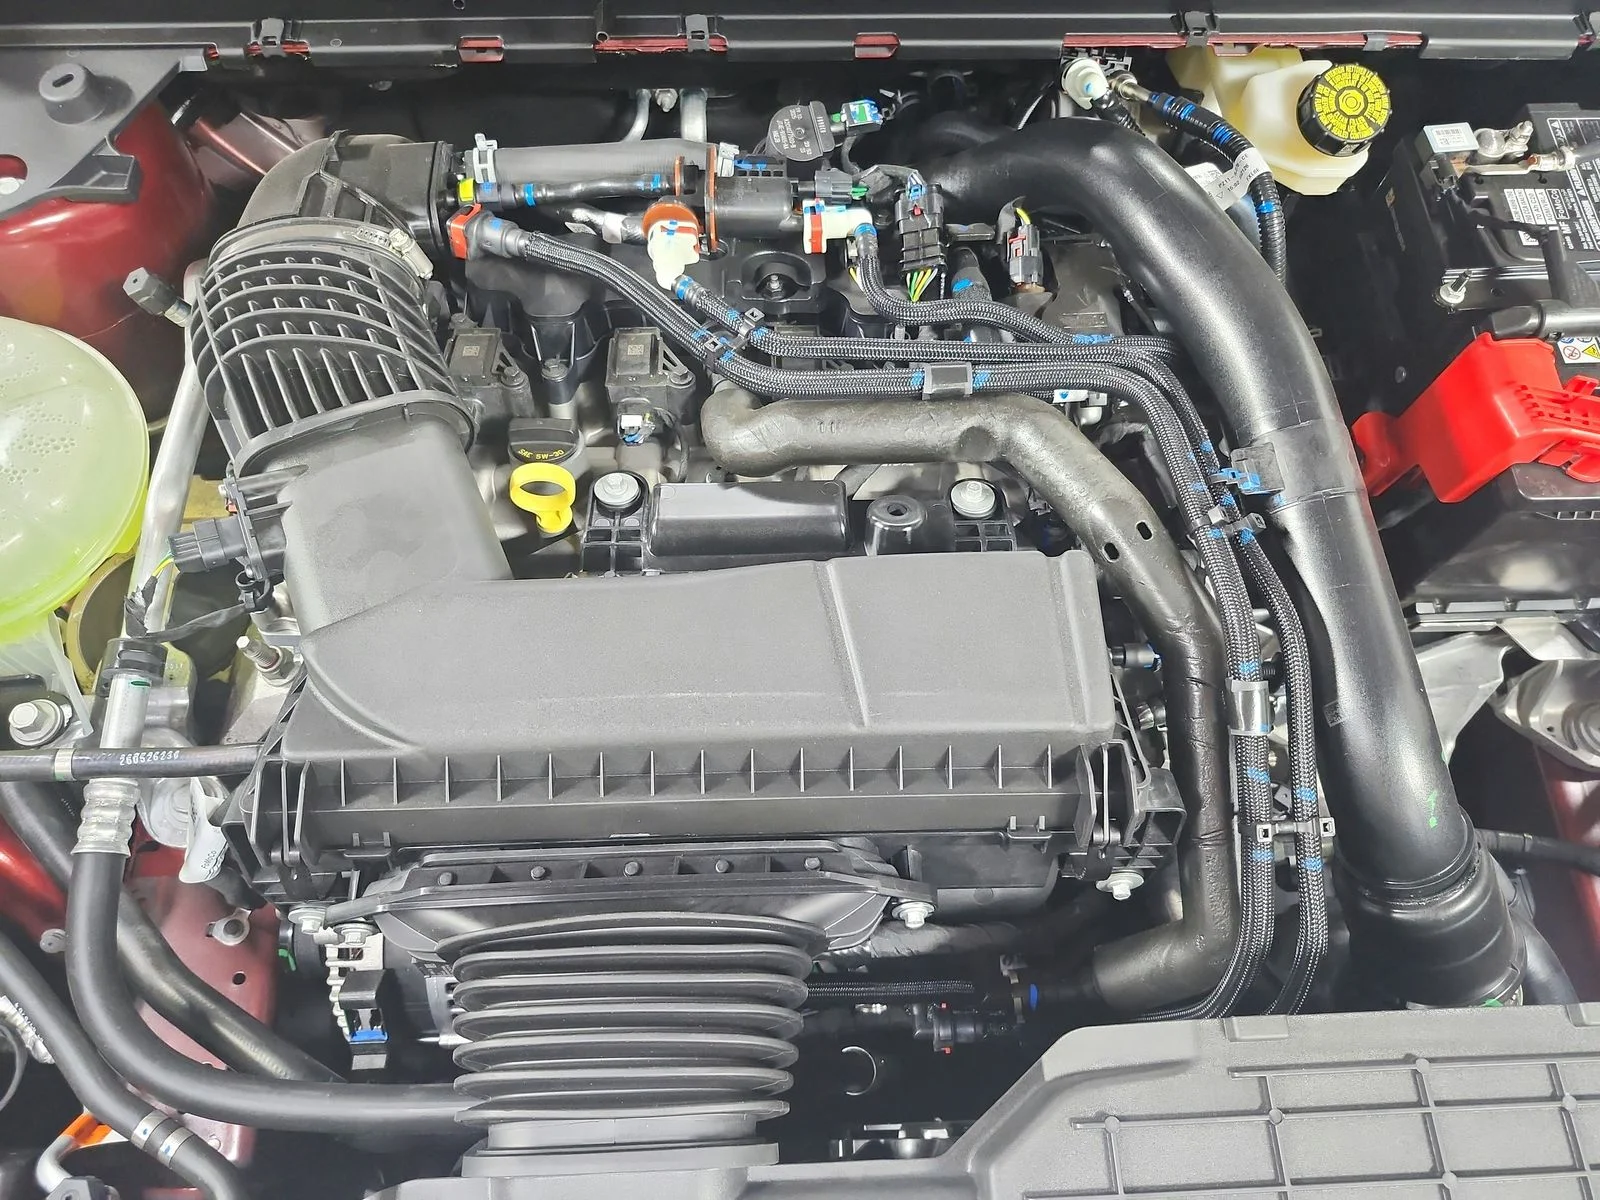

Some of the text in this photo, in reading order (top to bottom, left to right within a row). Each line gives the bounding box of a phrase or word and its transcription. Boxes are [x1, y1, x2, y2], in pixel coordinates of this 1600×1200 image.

[1549, 190, 1566, 218] FoMoCo
[1559, 222, 1572, 234] MF
[518, 448, 565, 459] SAE 5W-30
[200, 849, 216, 869] FoMoCo
